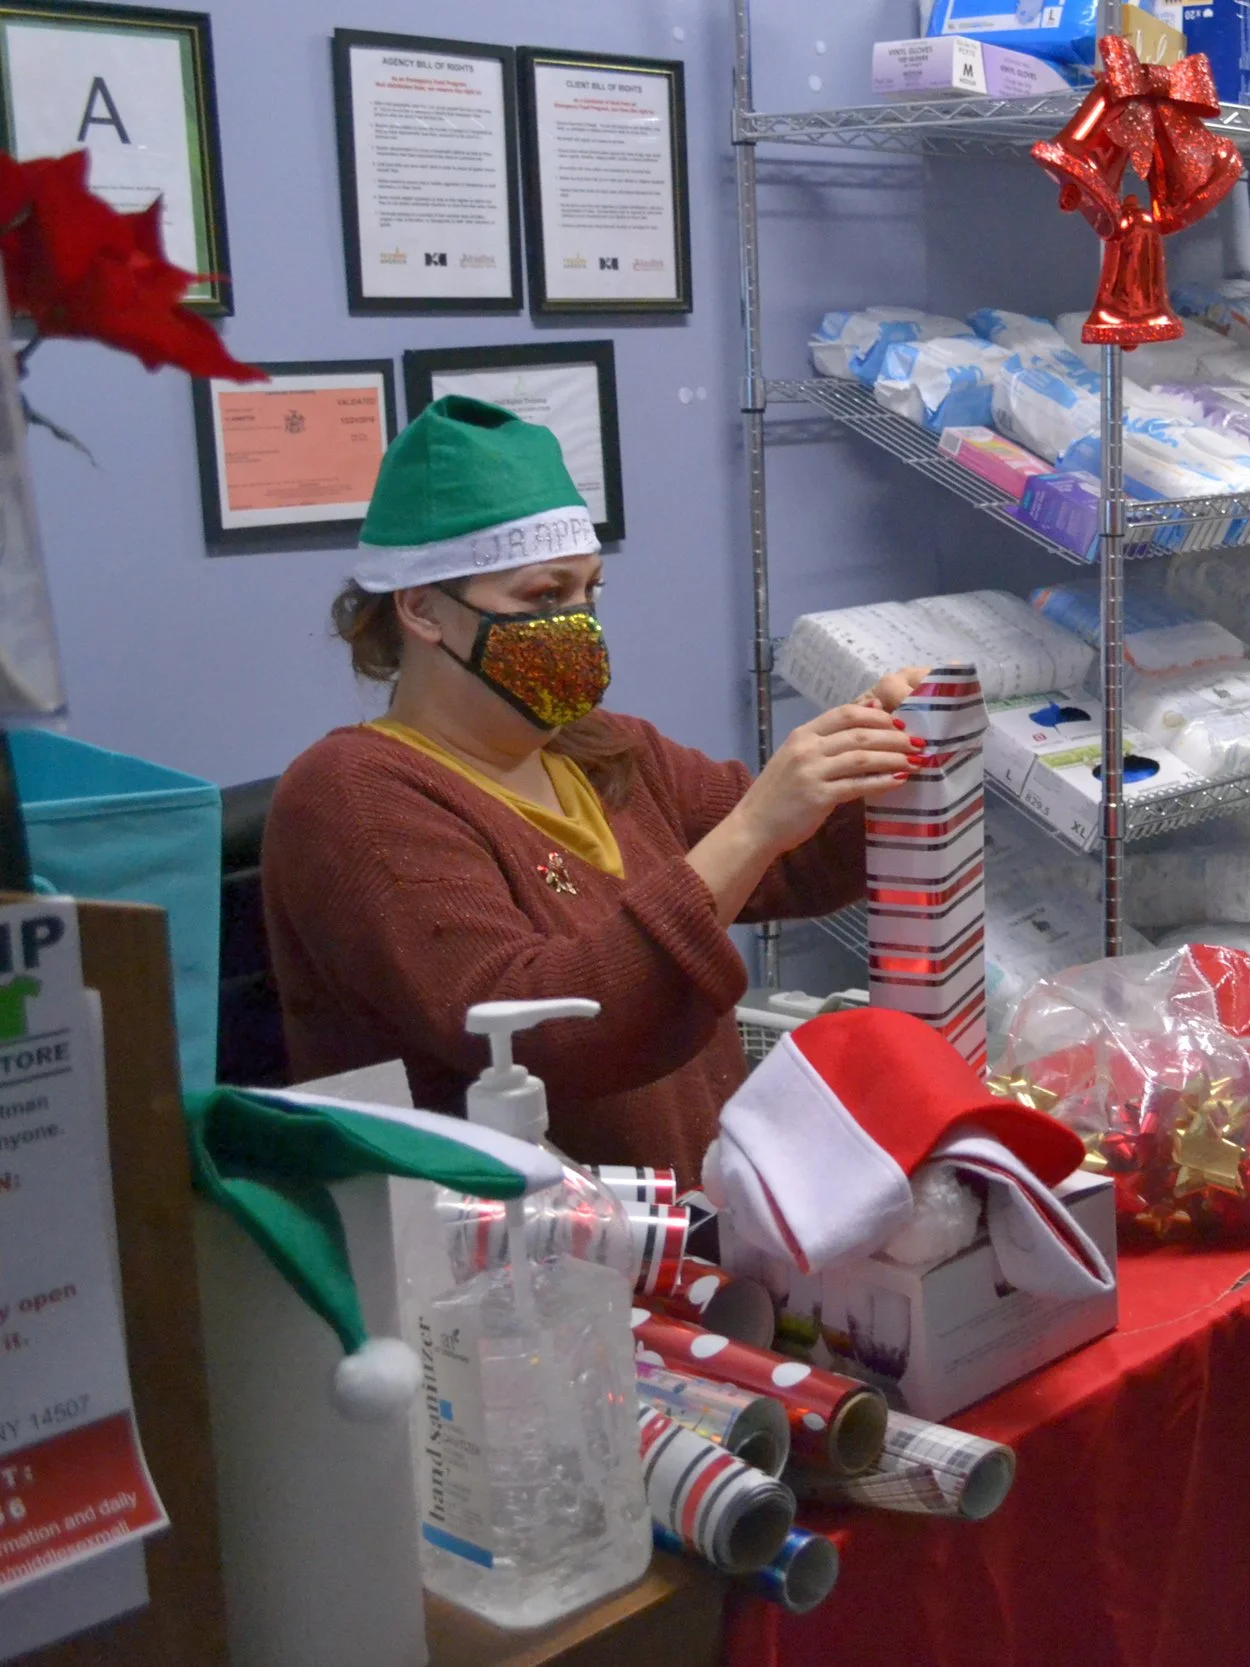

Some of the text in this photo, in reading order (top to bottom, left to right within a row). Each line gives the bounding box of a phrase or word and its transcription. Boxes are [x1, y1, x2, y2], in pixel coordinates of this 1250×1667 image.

[382, 57, 475, 73] AGENCY BILL OF RIGHTS
[963, 63, 974, 78] M
[566, 80, 642, 94] CLIENT BILL OF RIGHTS
[77, 77, 131, 145] A
[1006, 769, 1012, 780] L
[1071, 820, 1087, 839] XL
[19, 1284, 77, 1312] open
[30, 1394, 91, 1431] 14507
[426, 1447, 446, 1522] hand
[64, 1505, 97, 1531] and
[99, 1491, 137, 1516] daily
